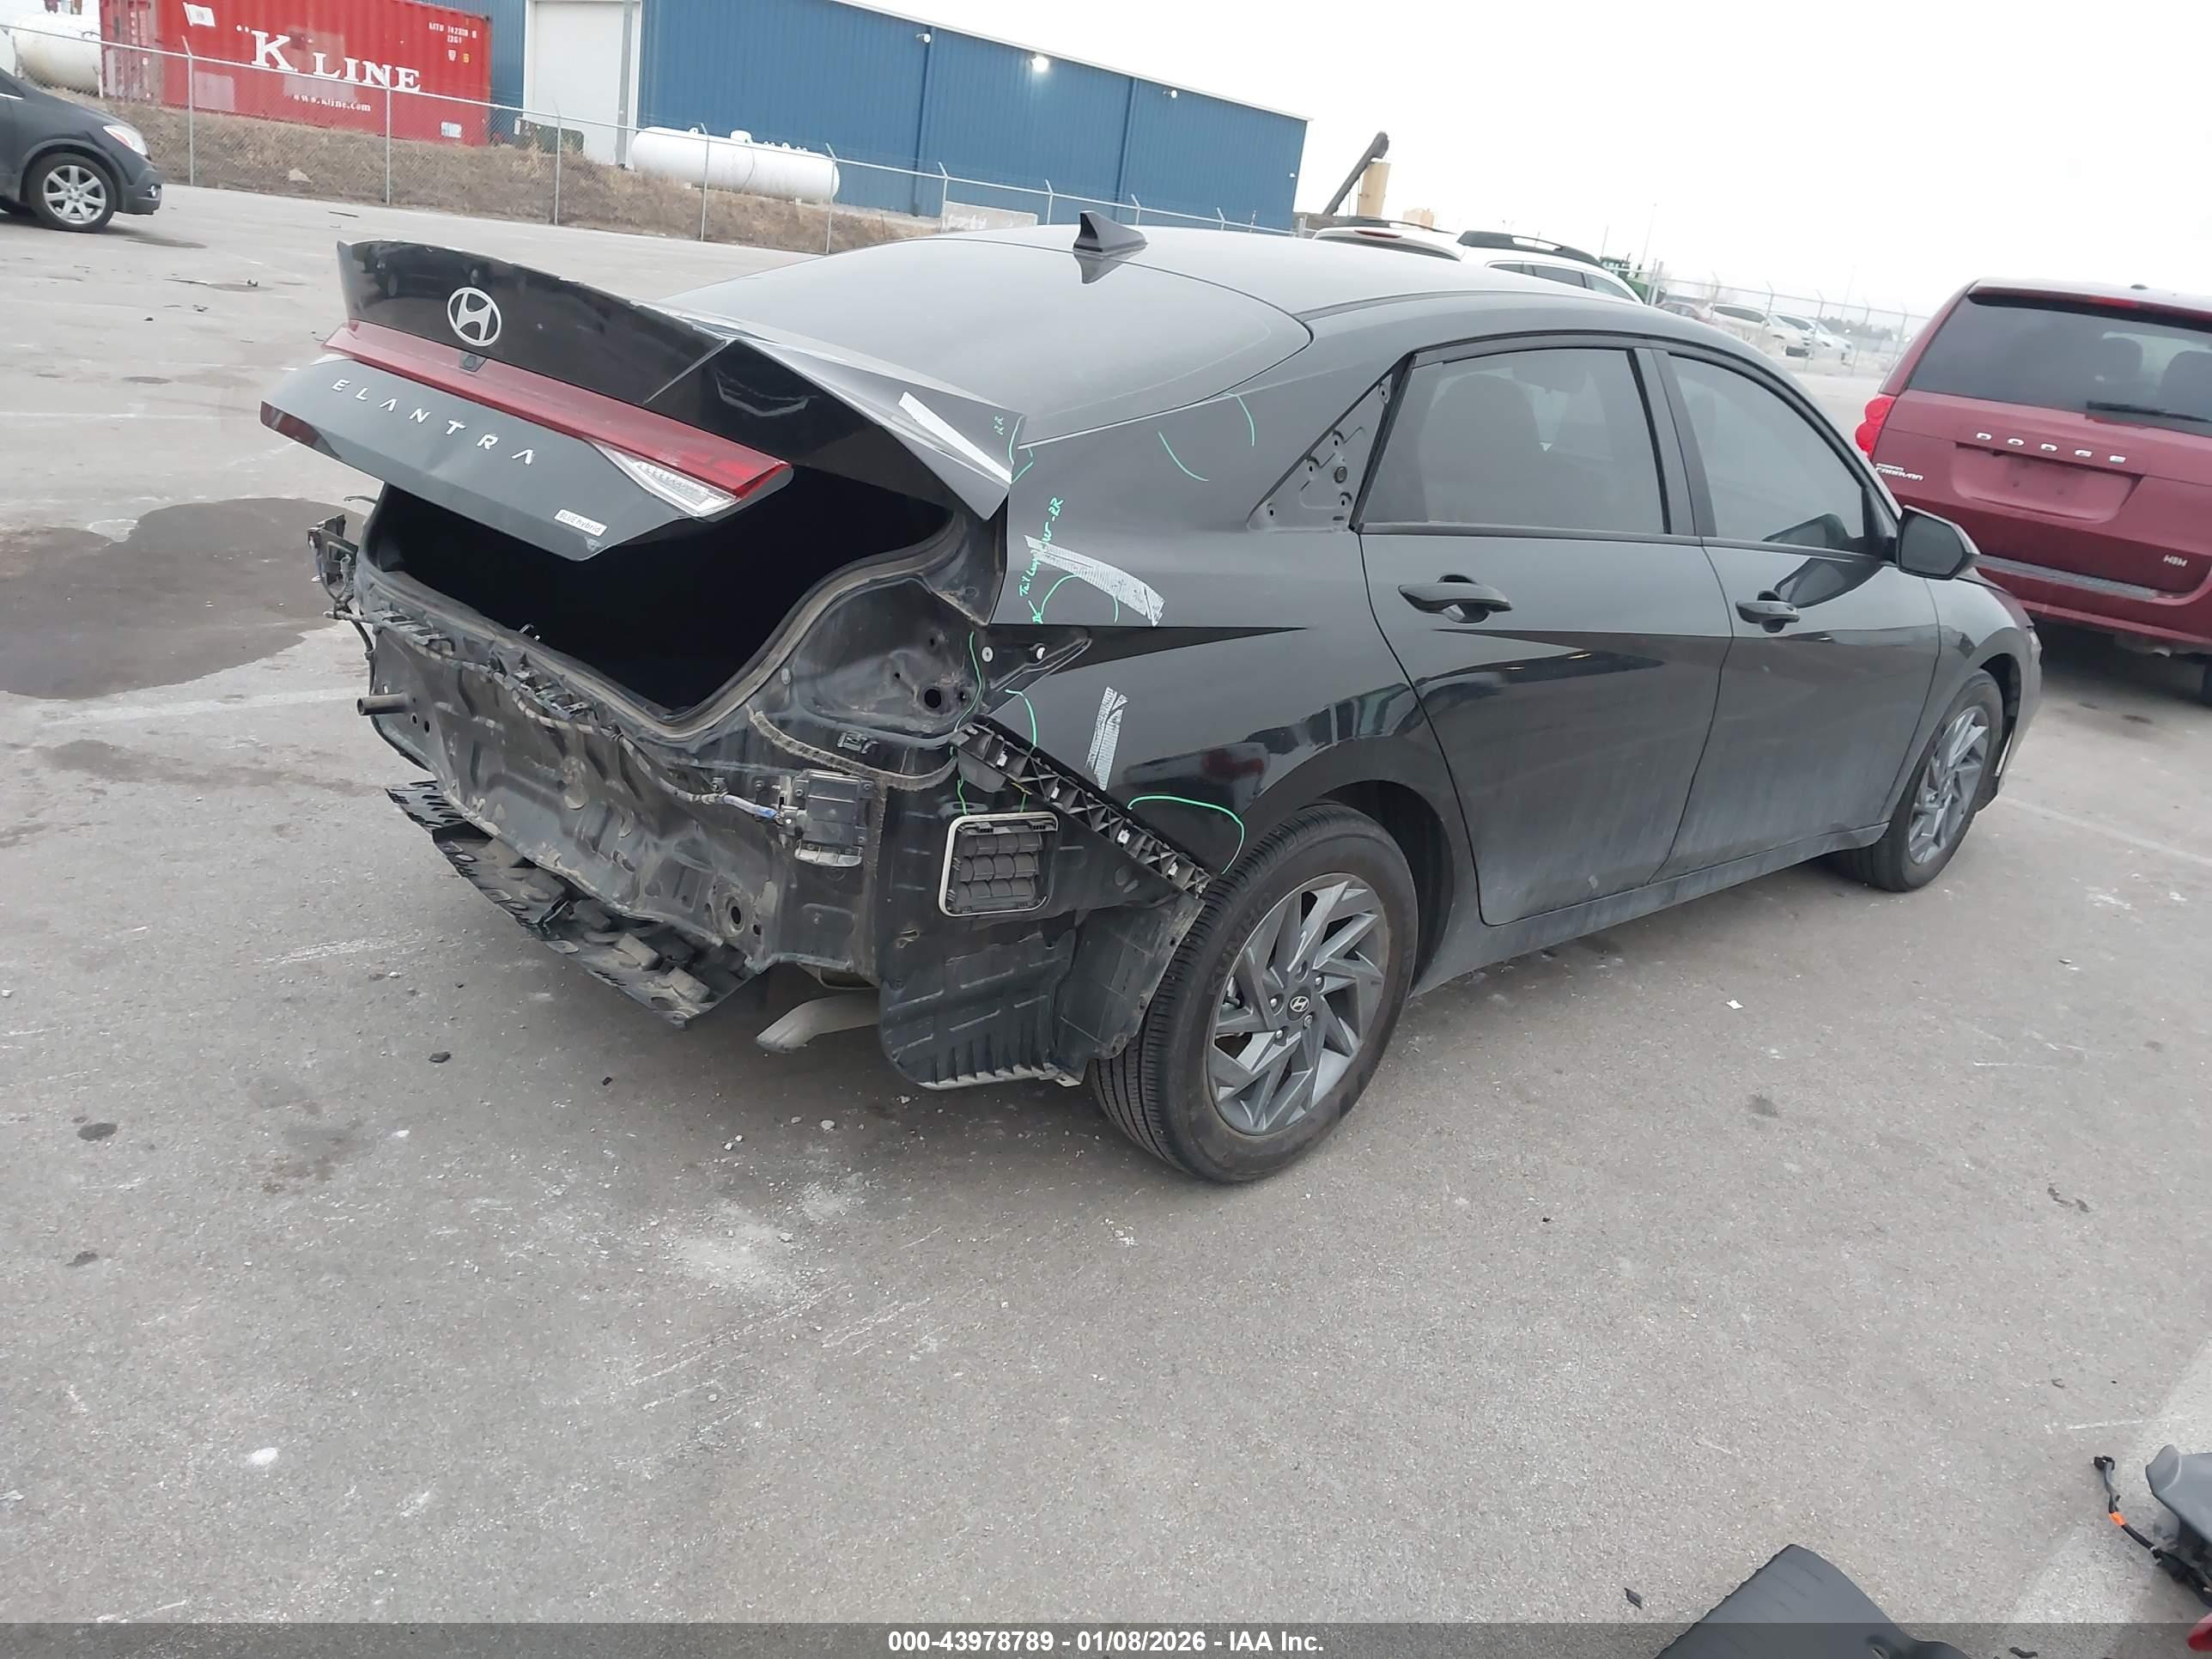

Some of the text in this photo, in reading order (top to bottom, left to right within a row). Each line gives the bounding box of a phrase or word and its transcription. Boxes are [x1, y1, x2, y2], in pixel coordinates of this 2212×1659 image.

[312, 52, 421, 93] LINE
[331, 378, 536, 465] ELANTRA
[1976, 432, 2126, 464] DODGE
[576, 518, 602, 533] hybrid
